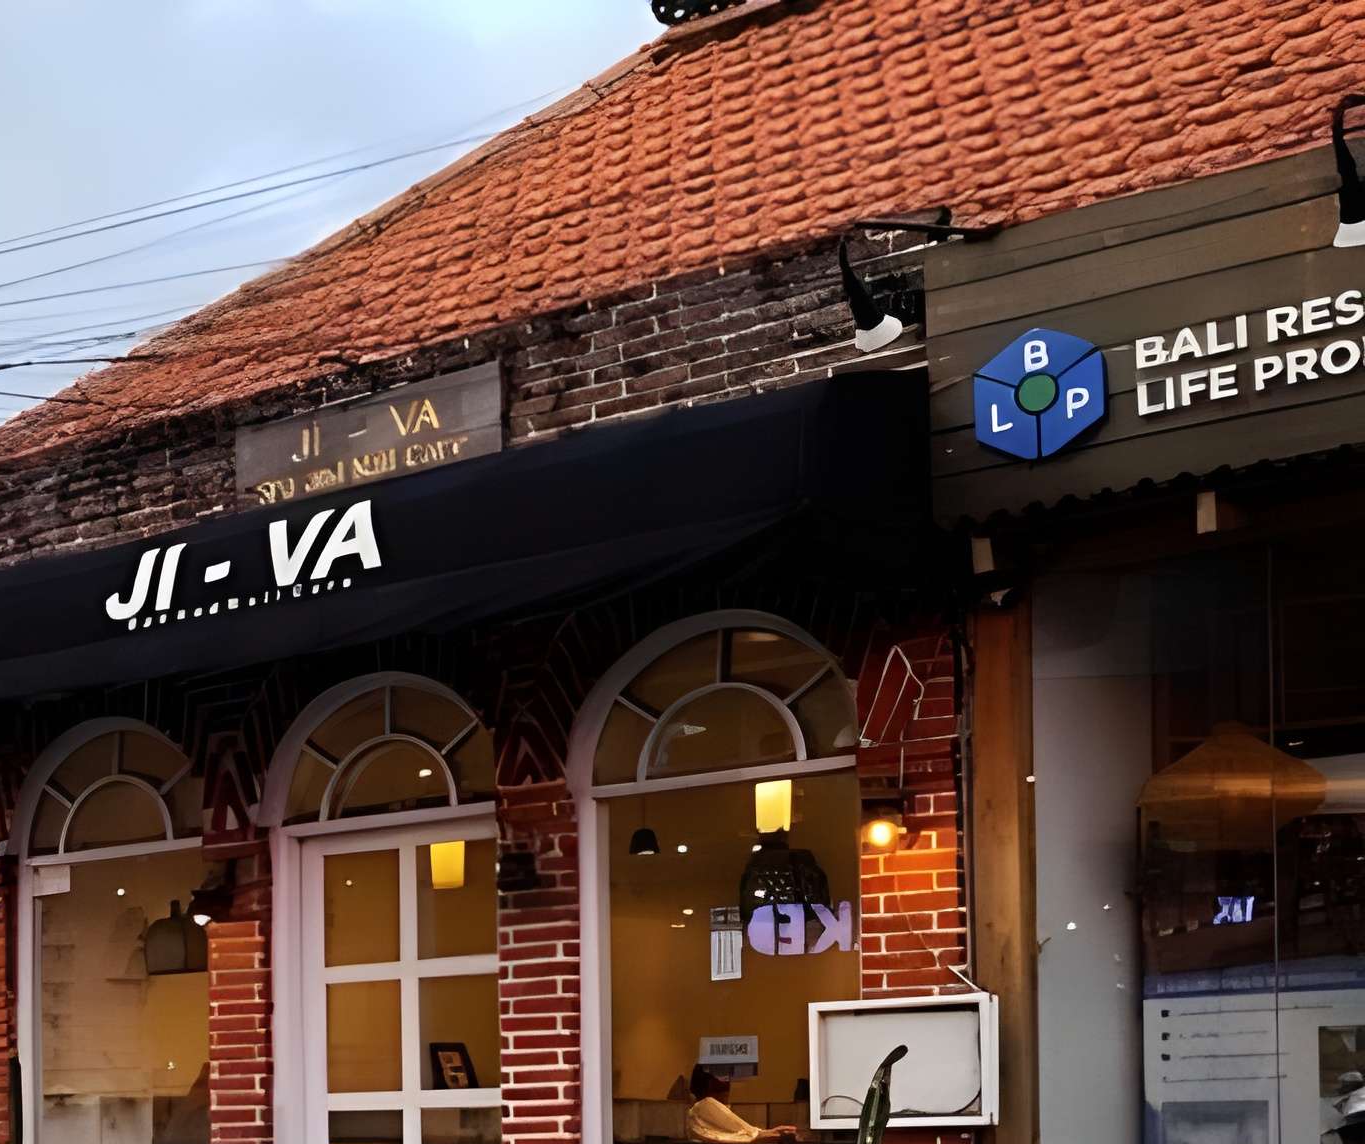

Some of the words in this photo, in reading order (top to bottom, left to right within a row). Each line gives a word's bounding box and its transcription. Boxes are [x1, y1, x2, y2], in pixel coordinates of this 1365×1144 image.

[1024, 340, 1049, 373] B
[1135, 314, 1248, 370] BALI
[1136, 363, 1239, 416] LIFE
[1254, 334, 1365, 391] PRO
[389, 398, 440, 436] VA
[991, 404, 1013, 433] L
[1067, 386, 1090, 419] P
[105, 542, 187, 621] JI
[268, 499, 382, 587] VA
